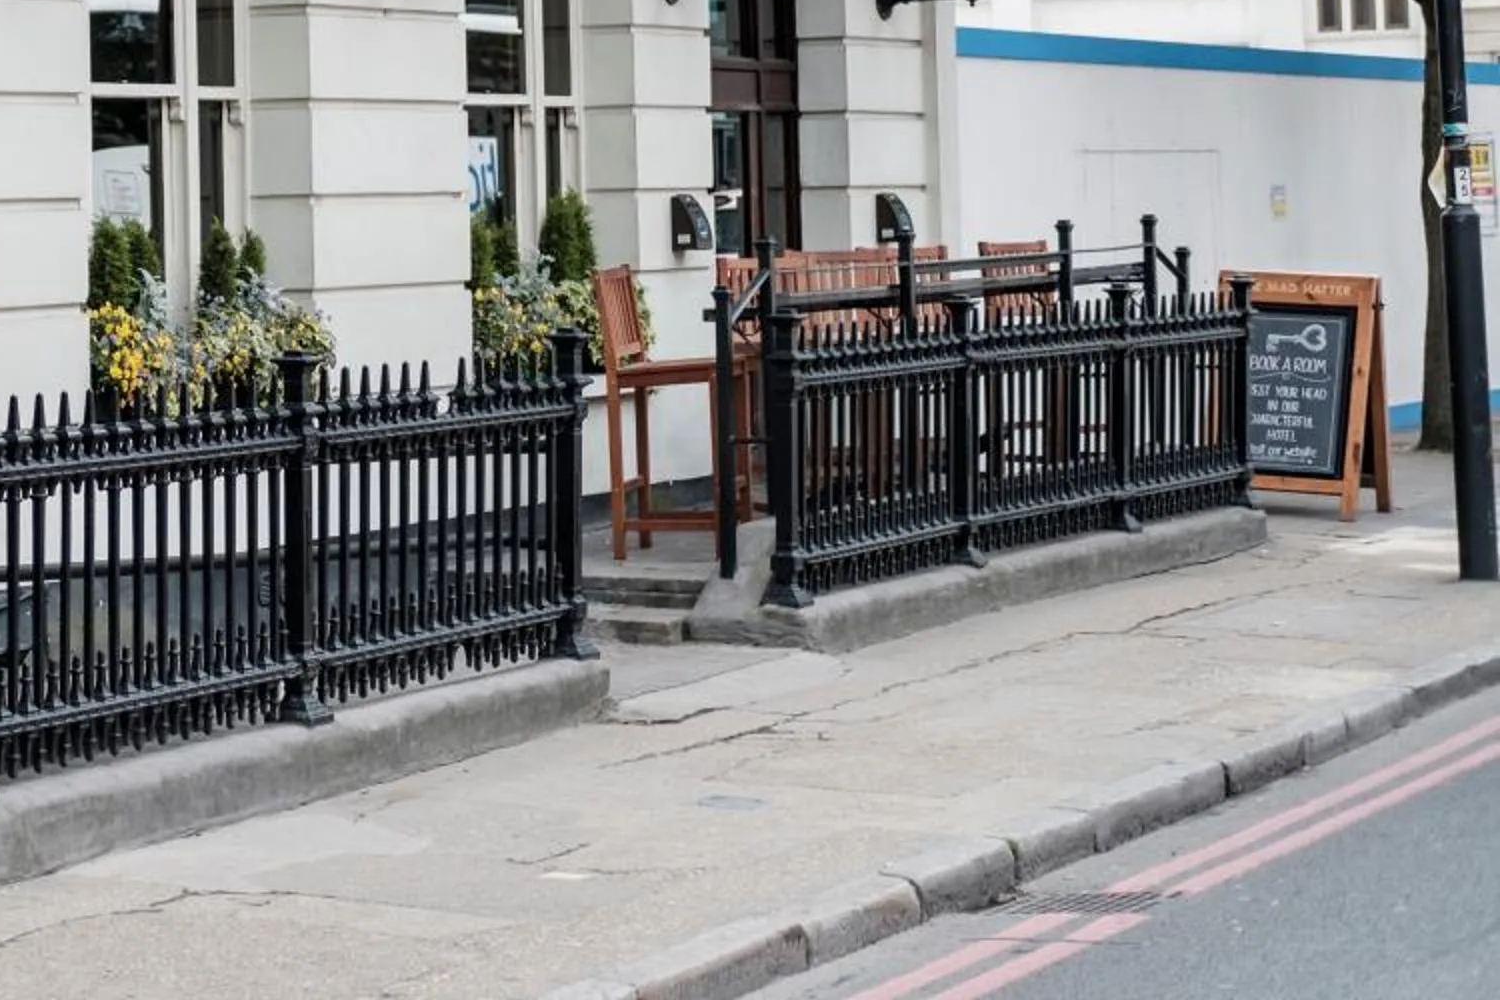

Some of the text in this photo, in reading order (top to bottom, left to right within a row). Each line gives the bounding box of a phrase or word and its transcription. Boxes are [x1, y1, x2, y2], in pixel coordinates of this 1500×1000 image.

[1265, 281, 1298, 294] MAD
[1249, 354, 1327, 374] BOOK A ROOM
[1301, 386, 1328, 400] HEAD
